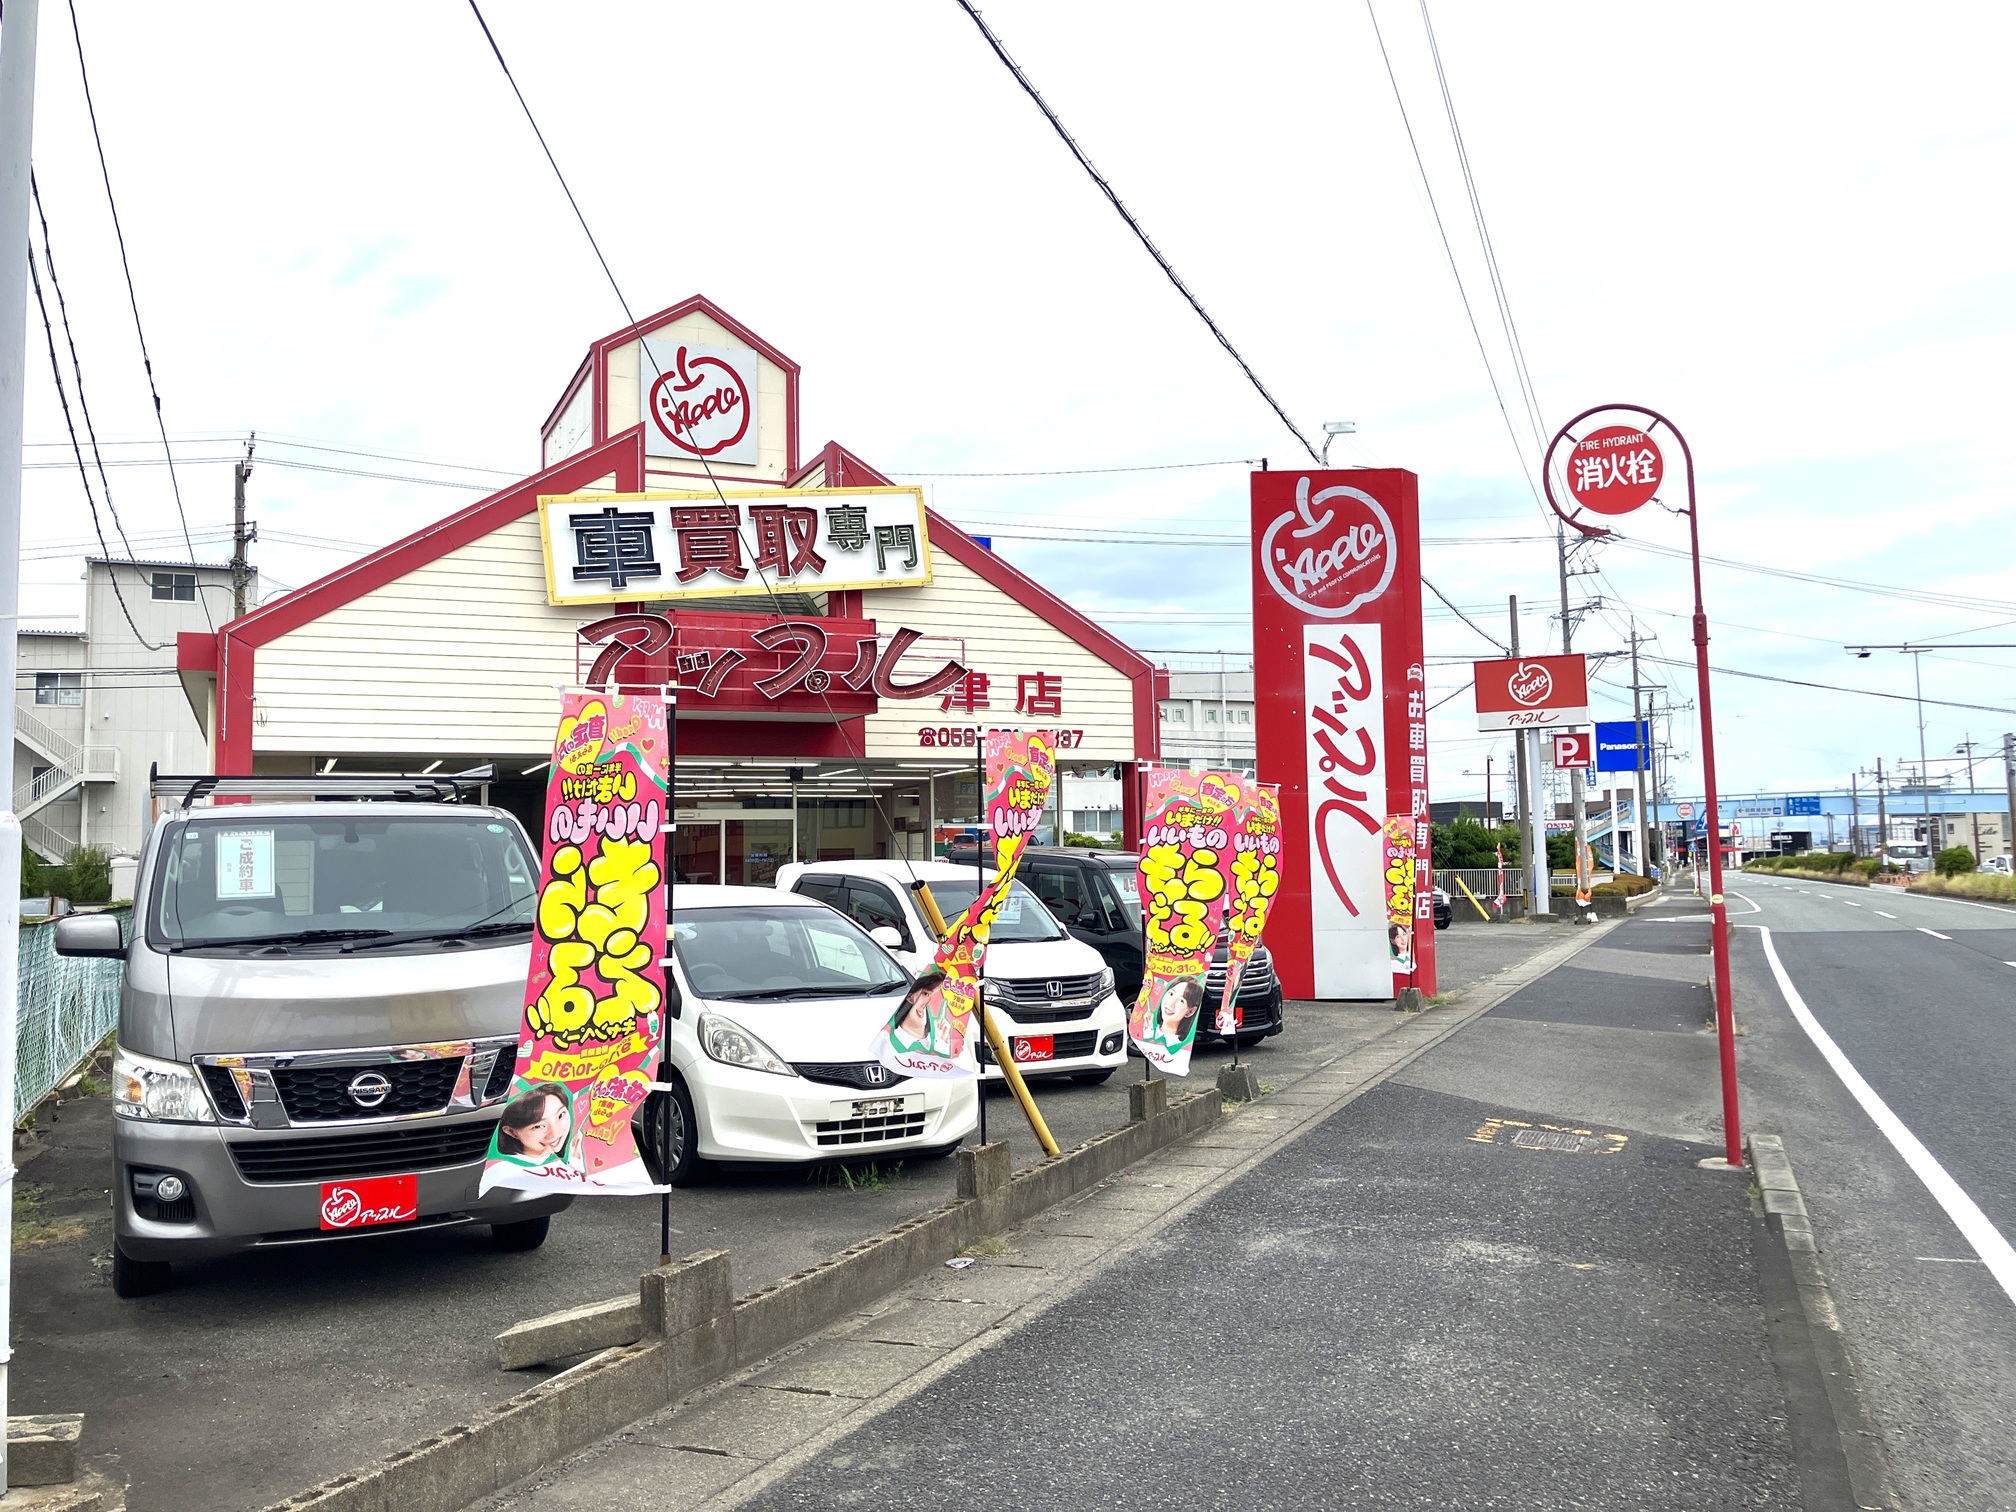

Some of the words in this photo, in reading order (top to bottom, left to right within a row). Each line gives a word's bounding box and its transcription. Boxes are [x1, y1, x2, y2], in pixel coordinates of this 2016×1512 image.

[665, 384, 740, 435] Apple
[1580, 440, 1600, 451] FIRE
[1602, 433, 1644, 448] HYDRANT
[1574, 448, 1657, 492] 消火栓
[1283, 523, 1384, 595] Apple
[577, 613, 970, 700] アップル
[1507, 711, 1560, 725] アップル
[1600, 742, 1645, 751] Panason
[1165, 810, 1223, 828] いまだけ!!
[1146, 825, 1229, 850] いいもの
[1234, 832, 1281, 854] いいもの
[239, 838, 254, 892] ご成約車
[351, 1086, 389, 1095] NISSAN
[360, 1205, 417, 1223] アップル
